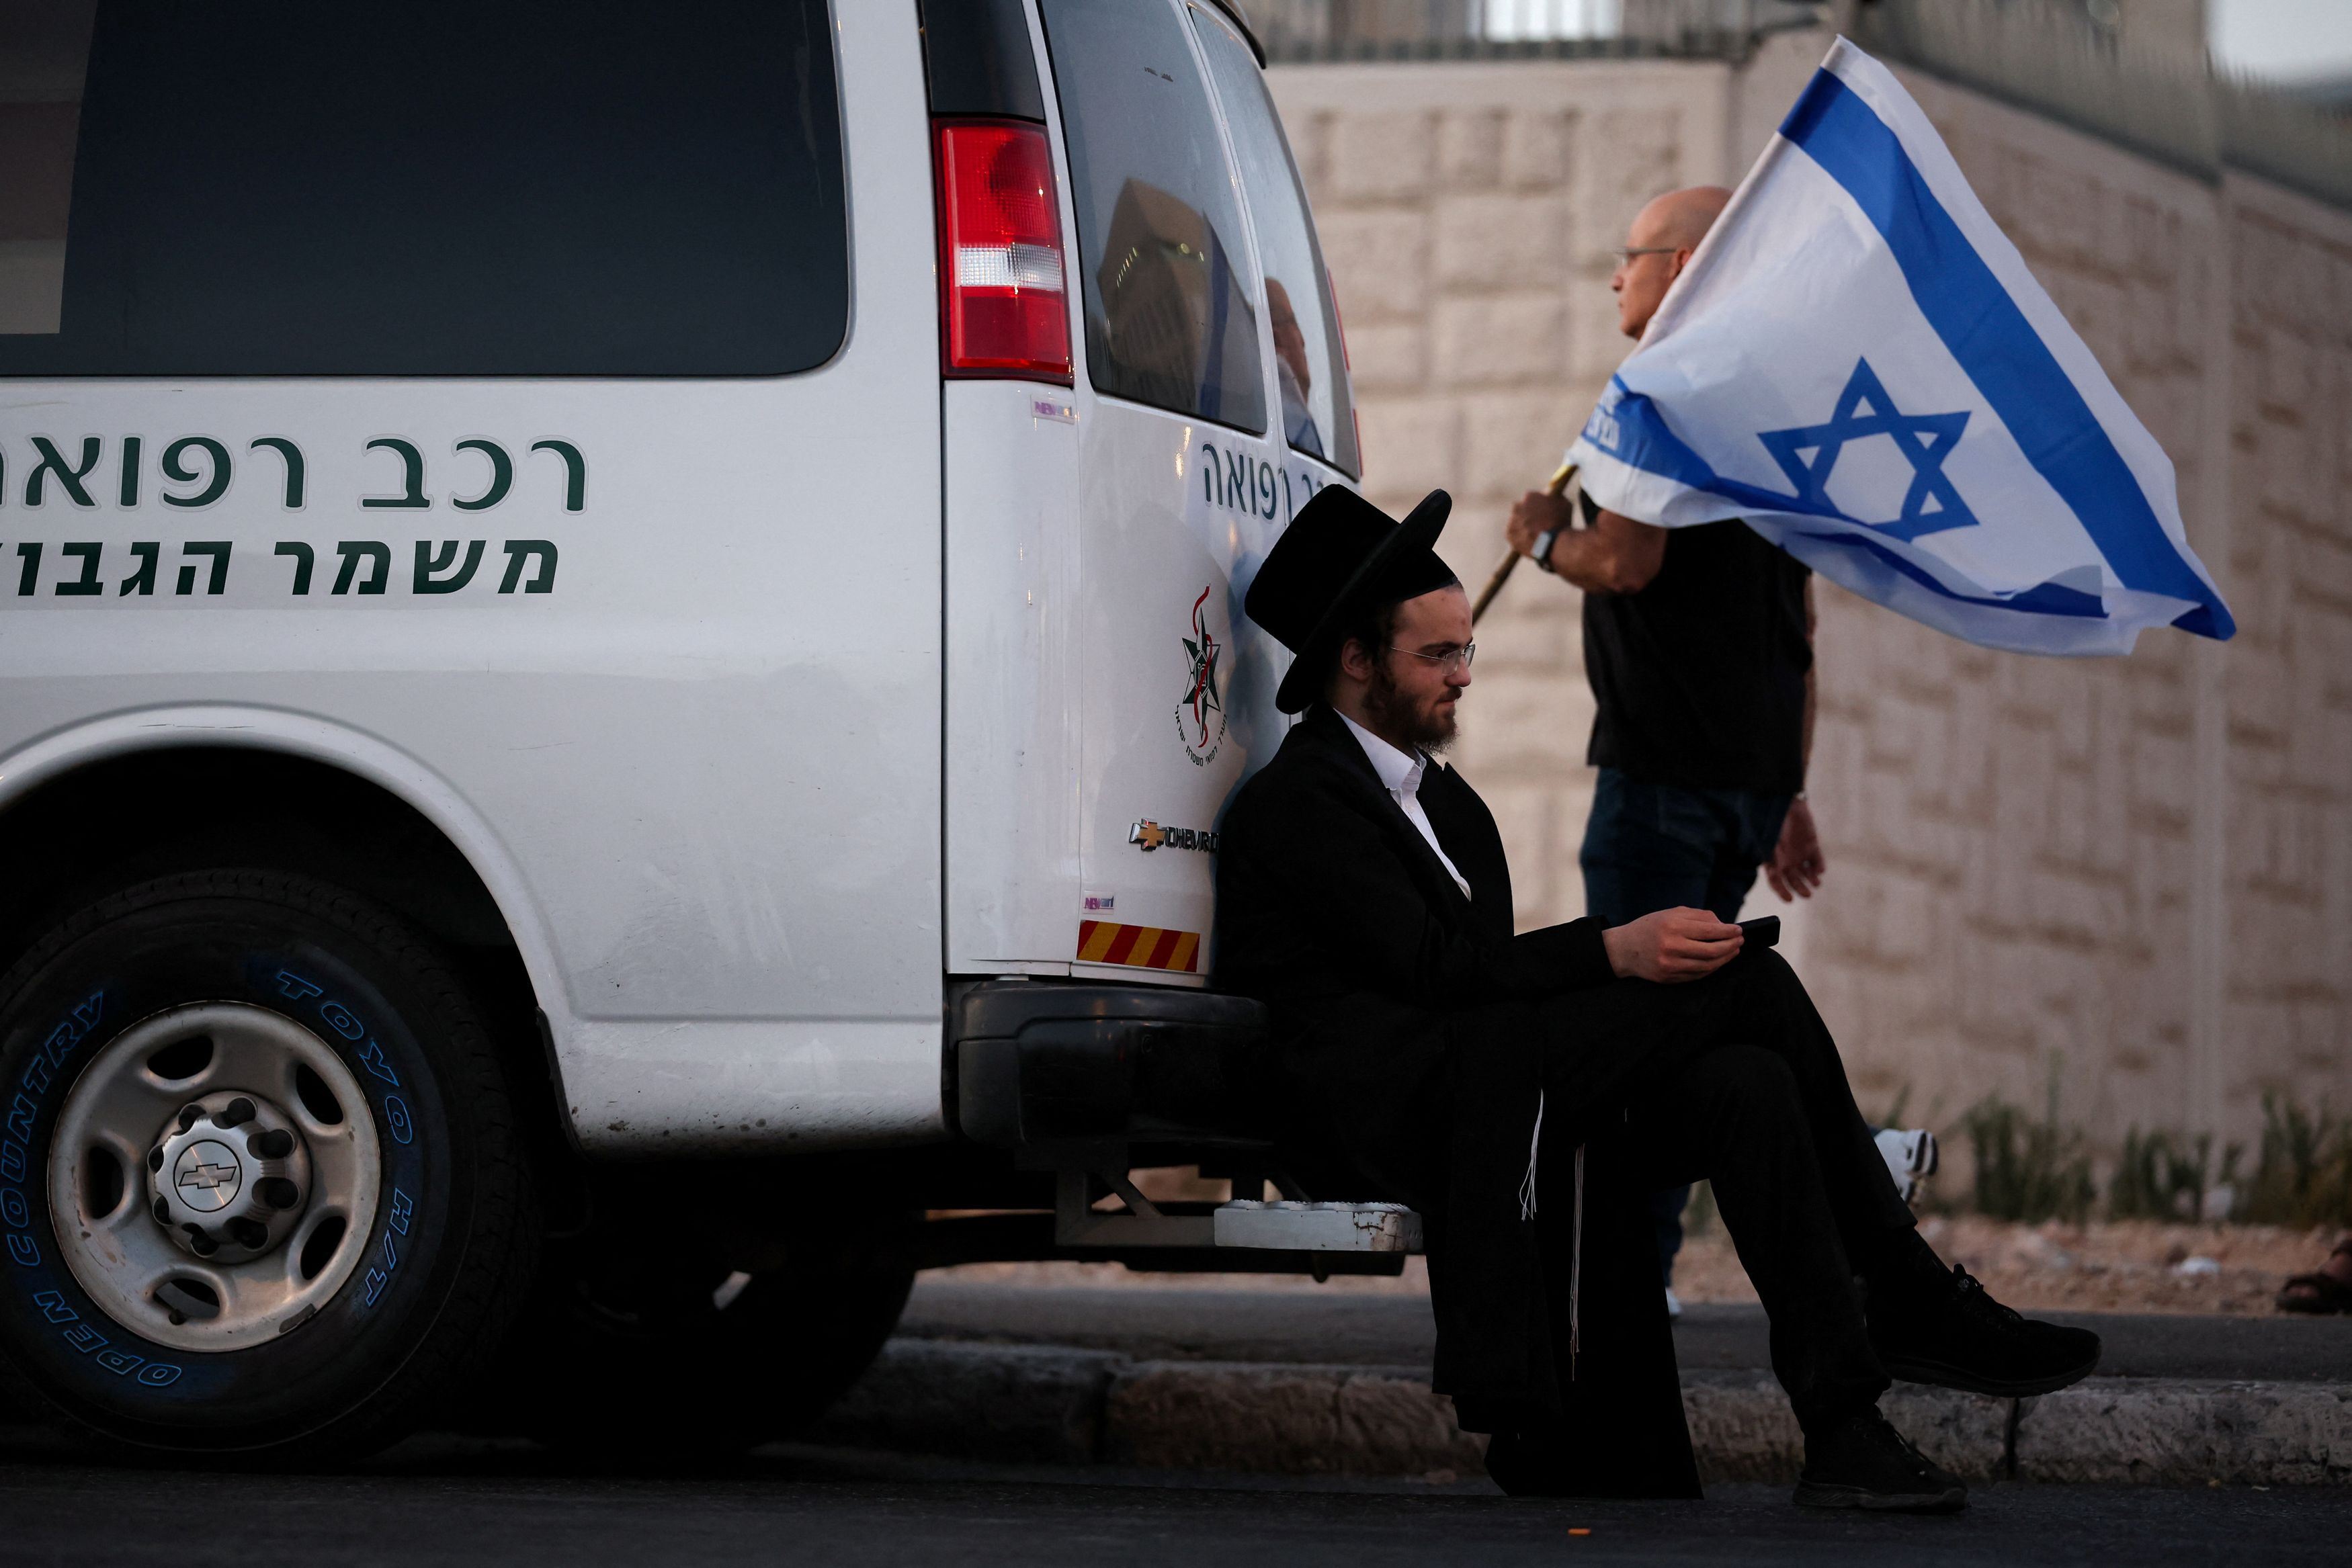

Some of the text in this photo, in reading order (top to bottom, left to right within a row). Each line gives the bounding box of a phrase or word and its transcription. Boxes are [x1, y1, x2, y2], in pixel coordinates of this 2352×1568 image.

[0, 435, 587, 513] רכב רפוא
[1202, 443, 1292, 522] רפואה
[0, 539, 558, 597] משמר הגבו
[277, 971, 412, 1143] TOYO
[1, 991, 181, 1386] OPEN COUNTRY
[366, 1187, 413, 1308] H/T
